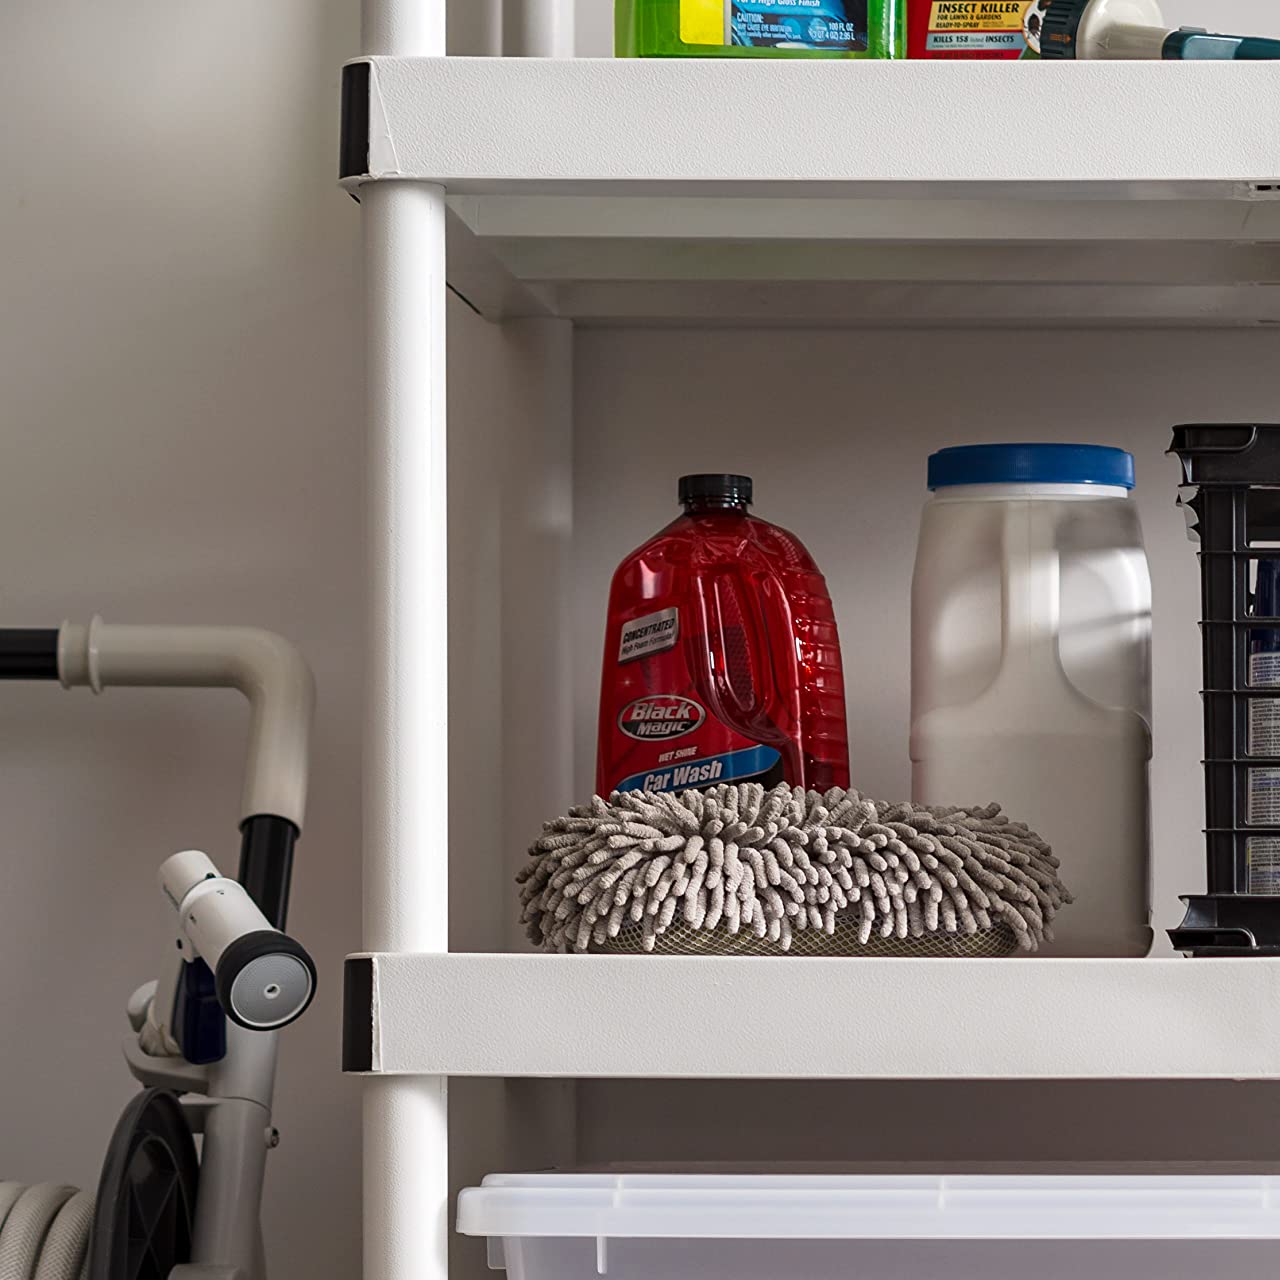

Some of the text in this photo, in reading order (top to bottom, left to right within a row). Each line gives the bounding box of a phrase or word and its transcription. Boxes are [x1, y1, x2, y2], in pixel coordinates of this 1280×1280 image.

[938, 3, 1020, 13] INSECT KILLER
[956, 35, 969, 43] 158
[985, 35, 1015, 43] INSECTS
[622, 617, 675, 644] CONCENTRATED
[630, 702, 693, 721] Black
[636, 721, 687, 736] Magic
[658, 746, 698, 763] WET SHINE
[642, 760, 723, 792] Car Wash
